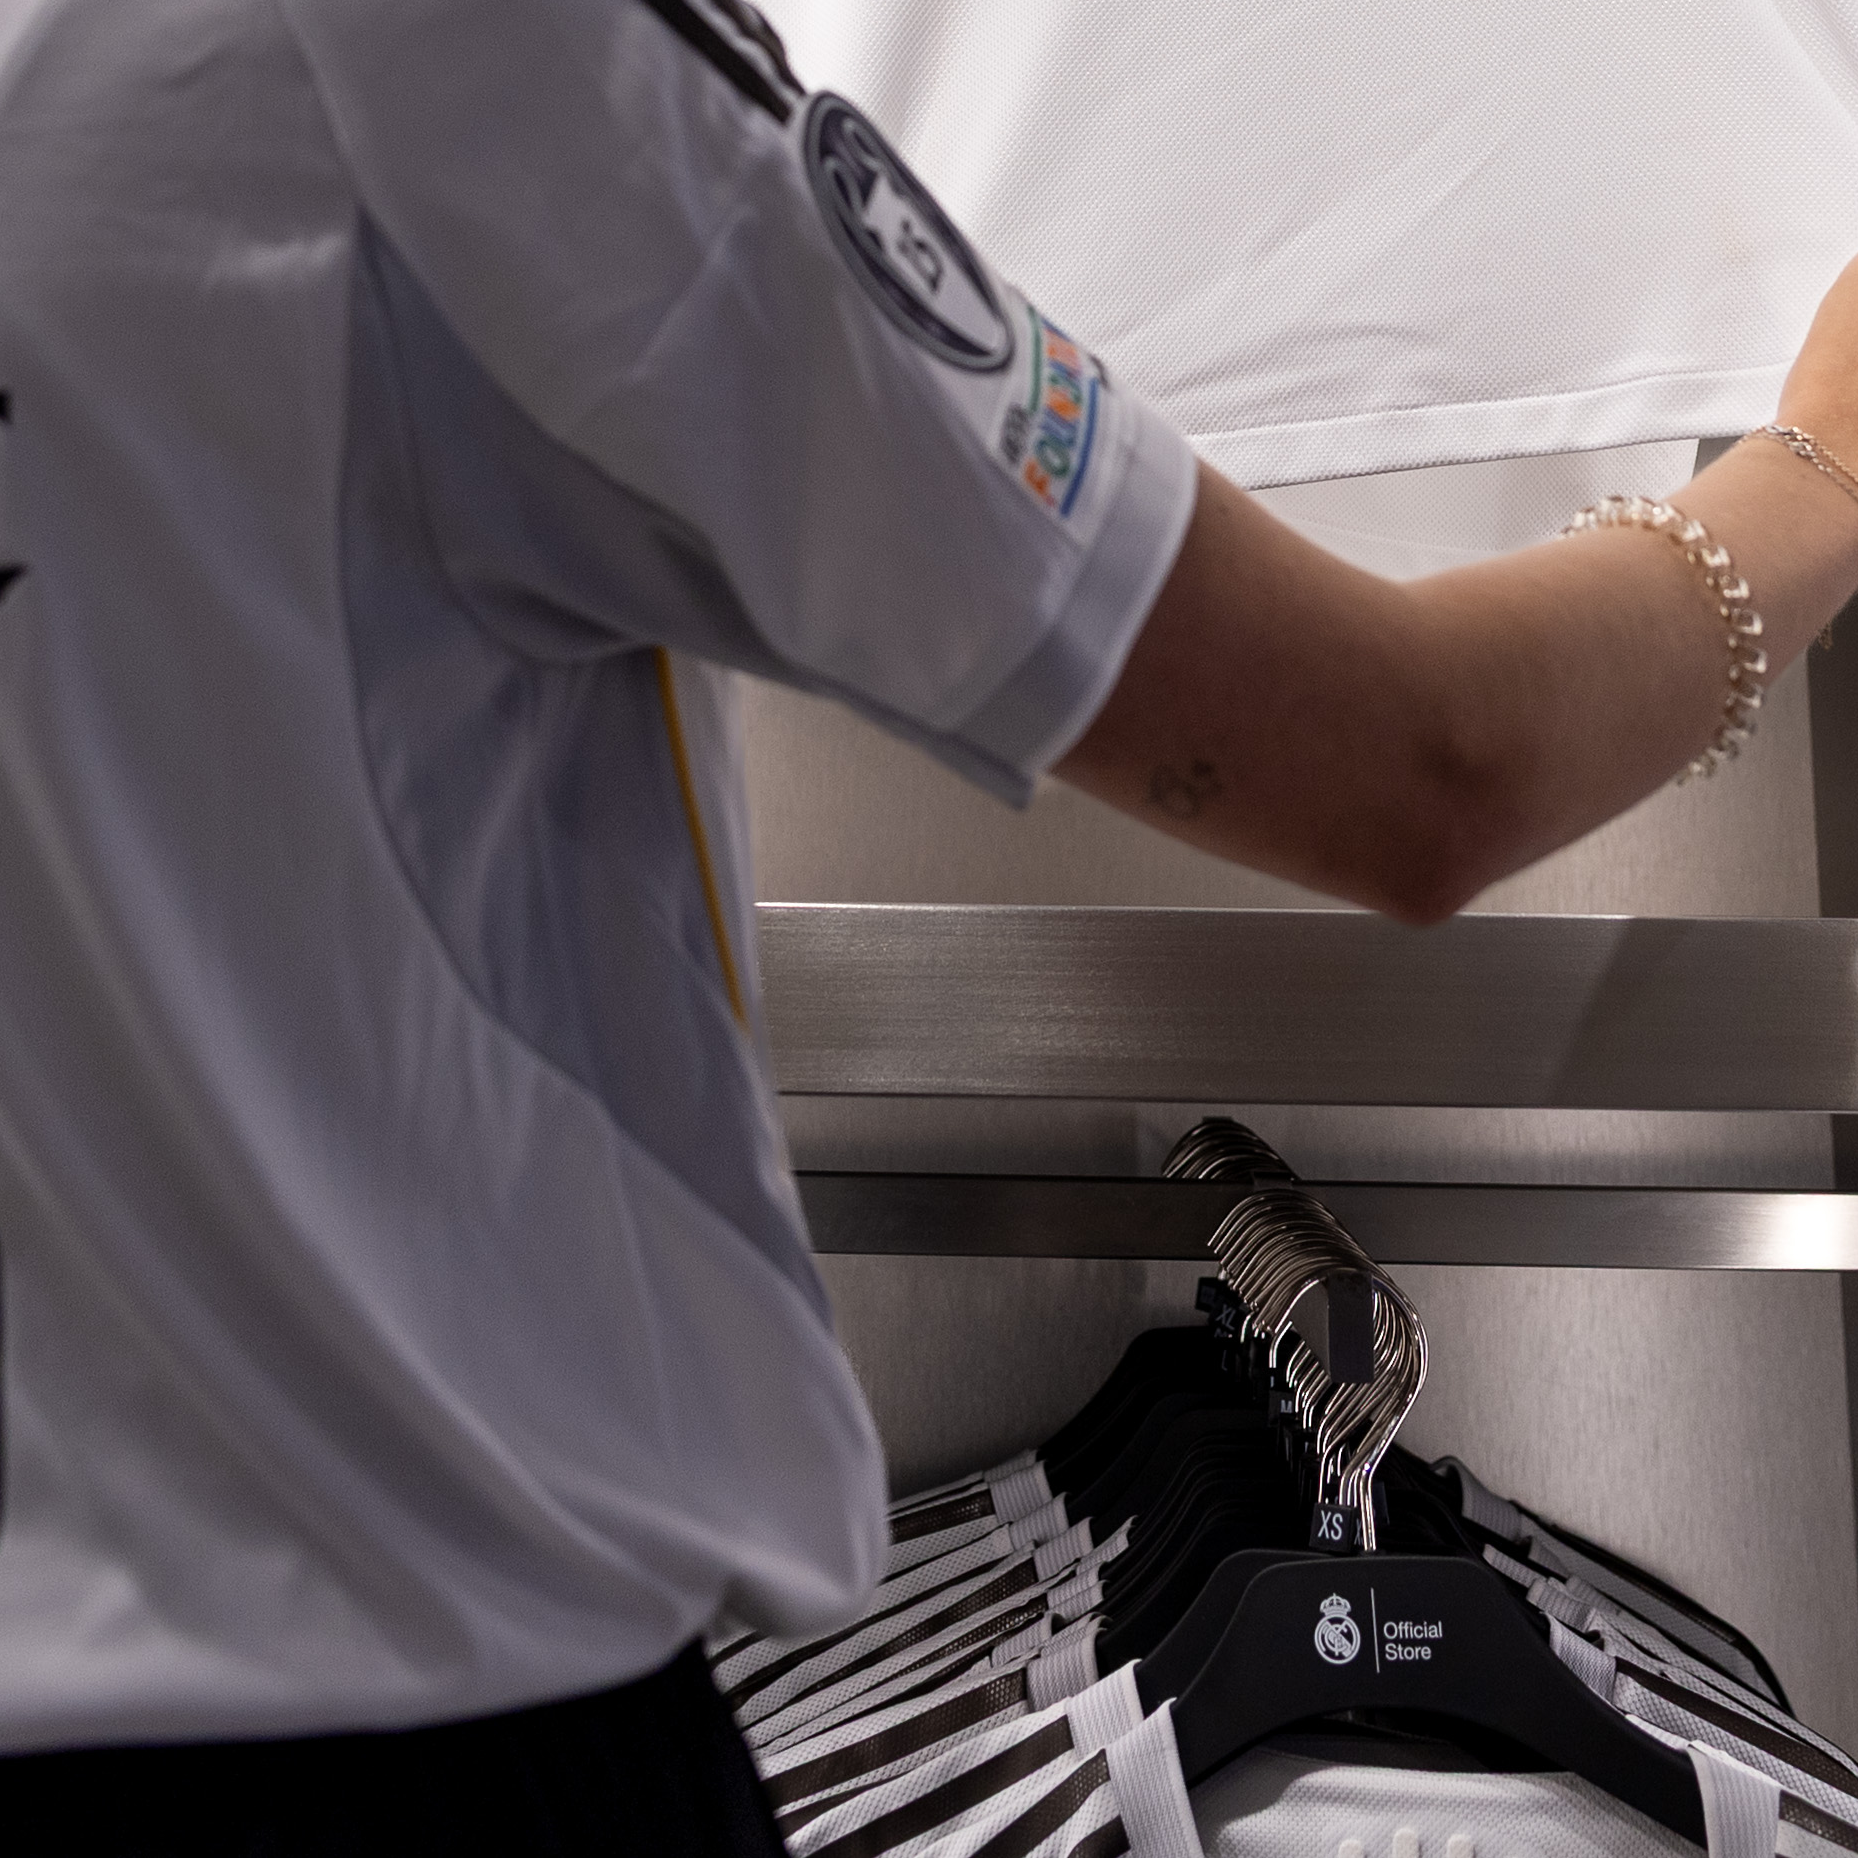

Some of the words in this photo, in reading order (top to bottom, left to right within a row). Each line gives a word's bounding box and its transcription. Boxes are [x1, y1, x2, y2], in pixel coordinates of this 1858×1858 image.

[1317, 1509, 1344, 1541] XS
[1383, 1620, 1444, 1640] Official
[1383, 1642, 1433, 1661] Store
